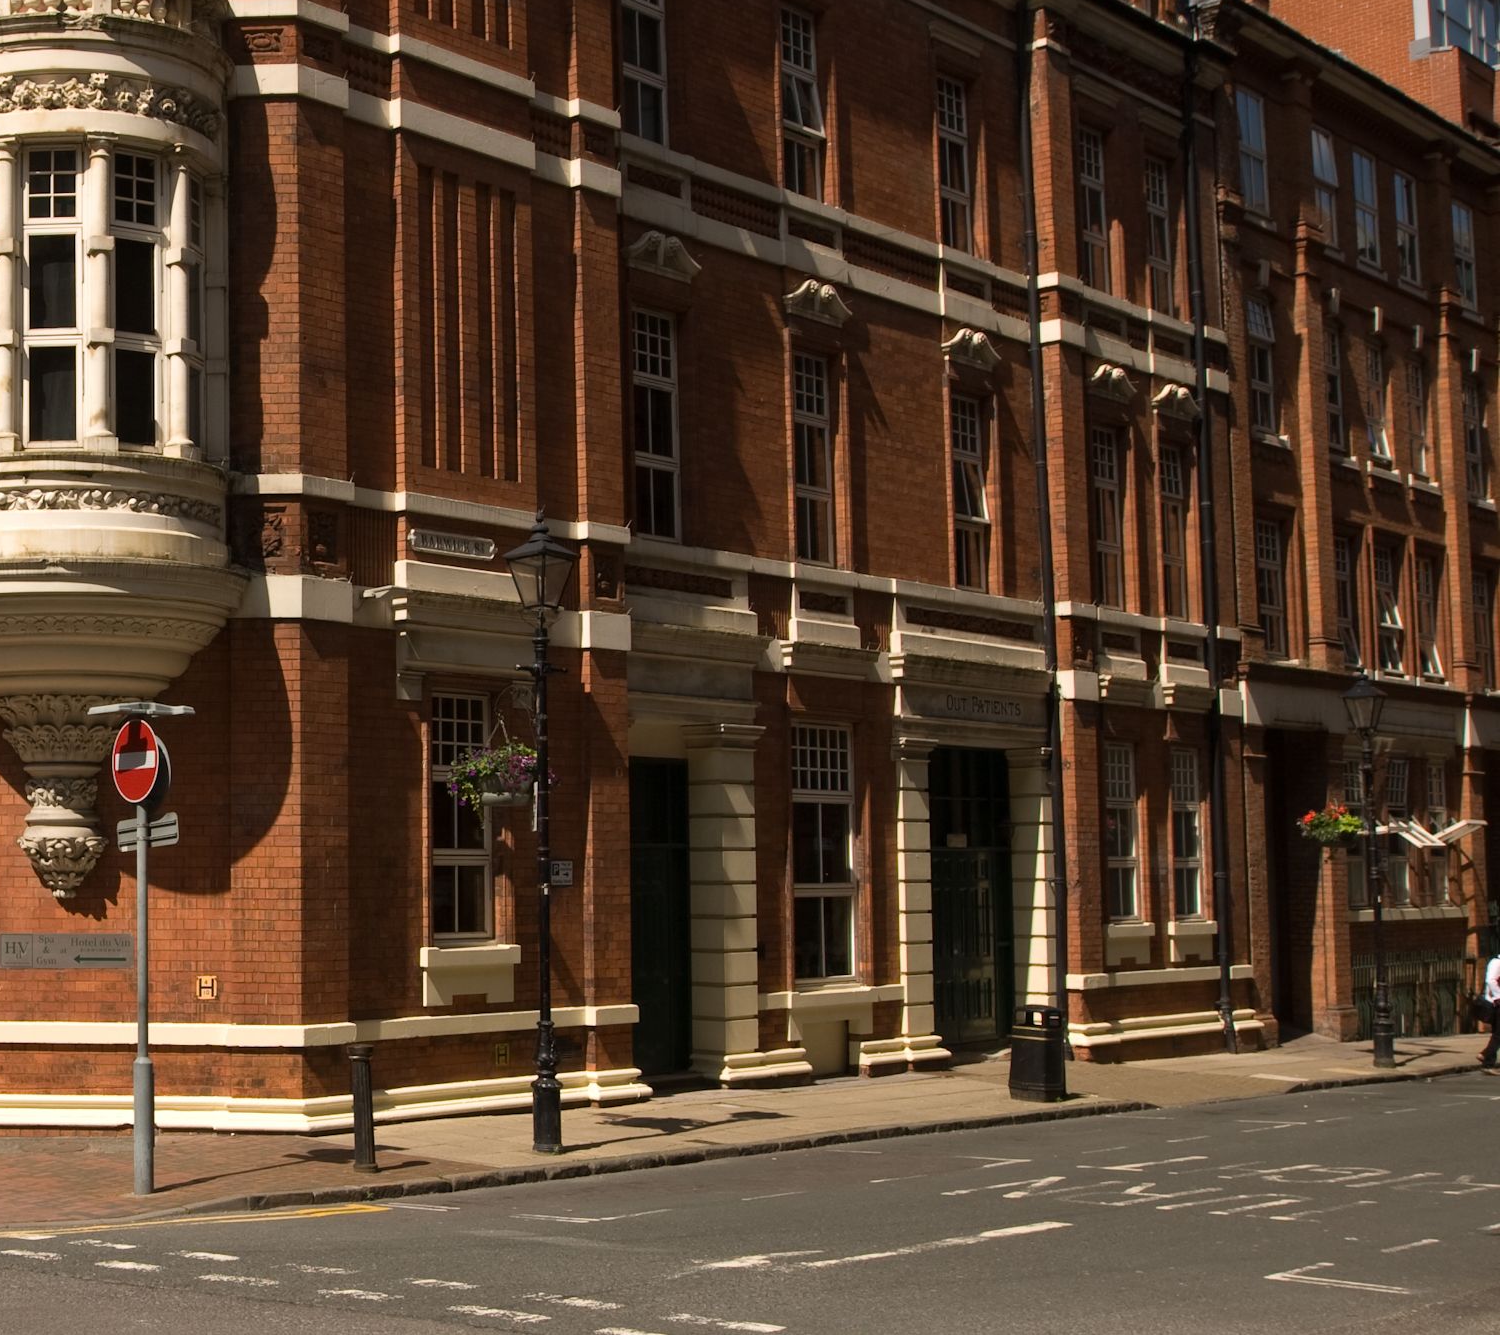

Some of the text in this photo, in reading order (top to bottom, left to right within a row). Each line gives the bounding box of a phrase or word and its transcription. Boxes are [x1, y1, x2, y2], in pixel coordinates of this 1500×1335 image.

[946, 694, 1022, 716] OUT PATIENTS
[38, 935, 55, 944] Spa
[71, 937, 131, 947] Hotel du Vin
[42, 945, 51, 954] &
[36, 956, 57, 965] Gym
